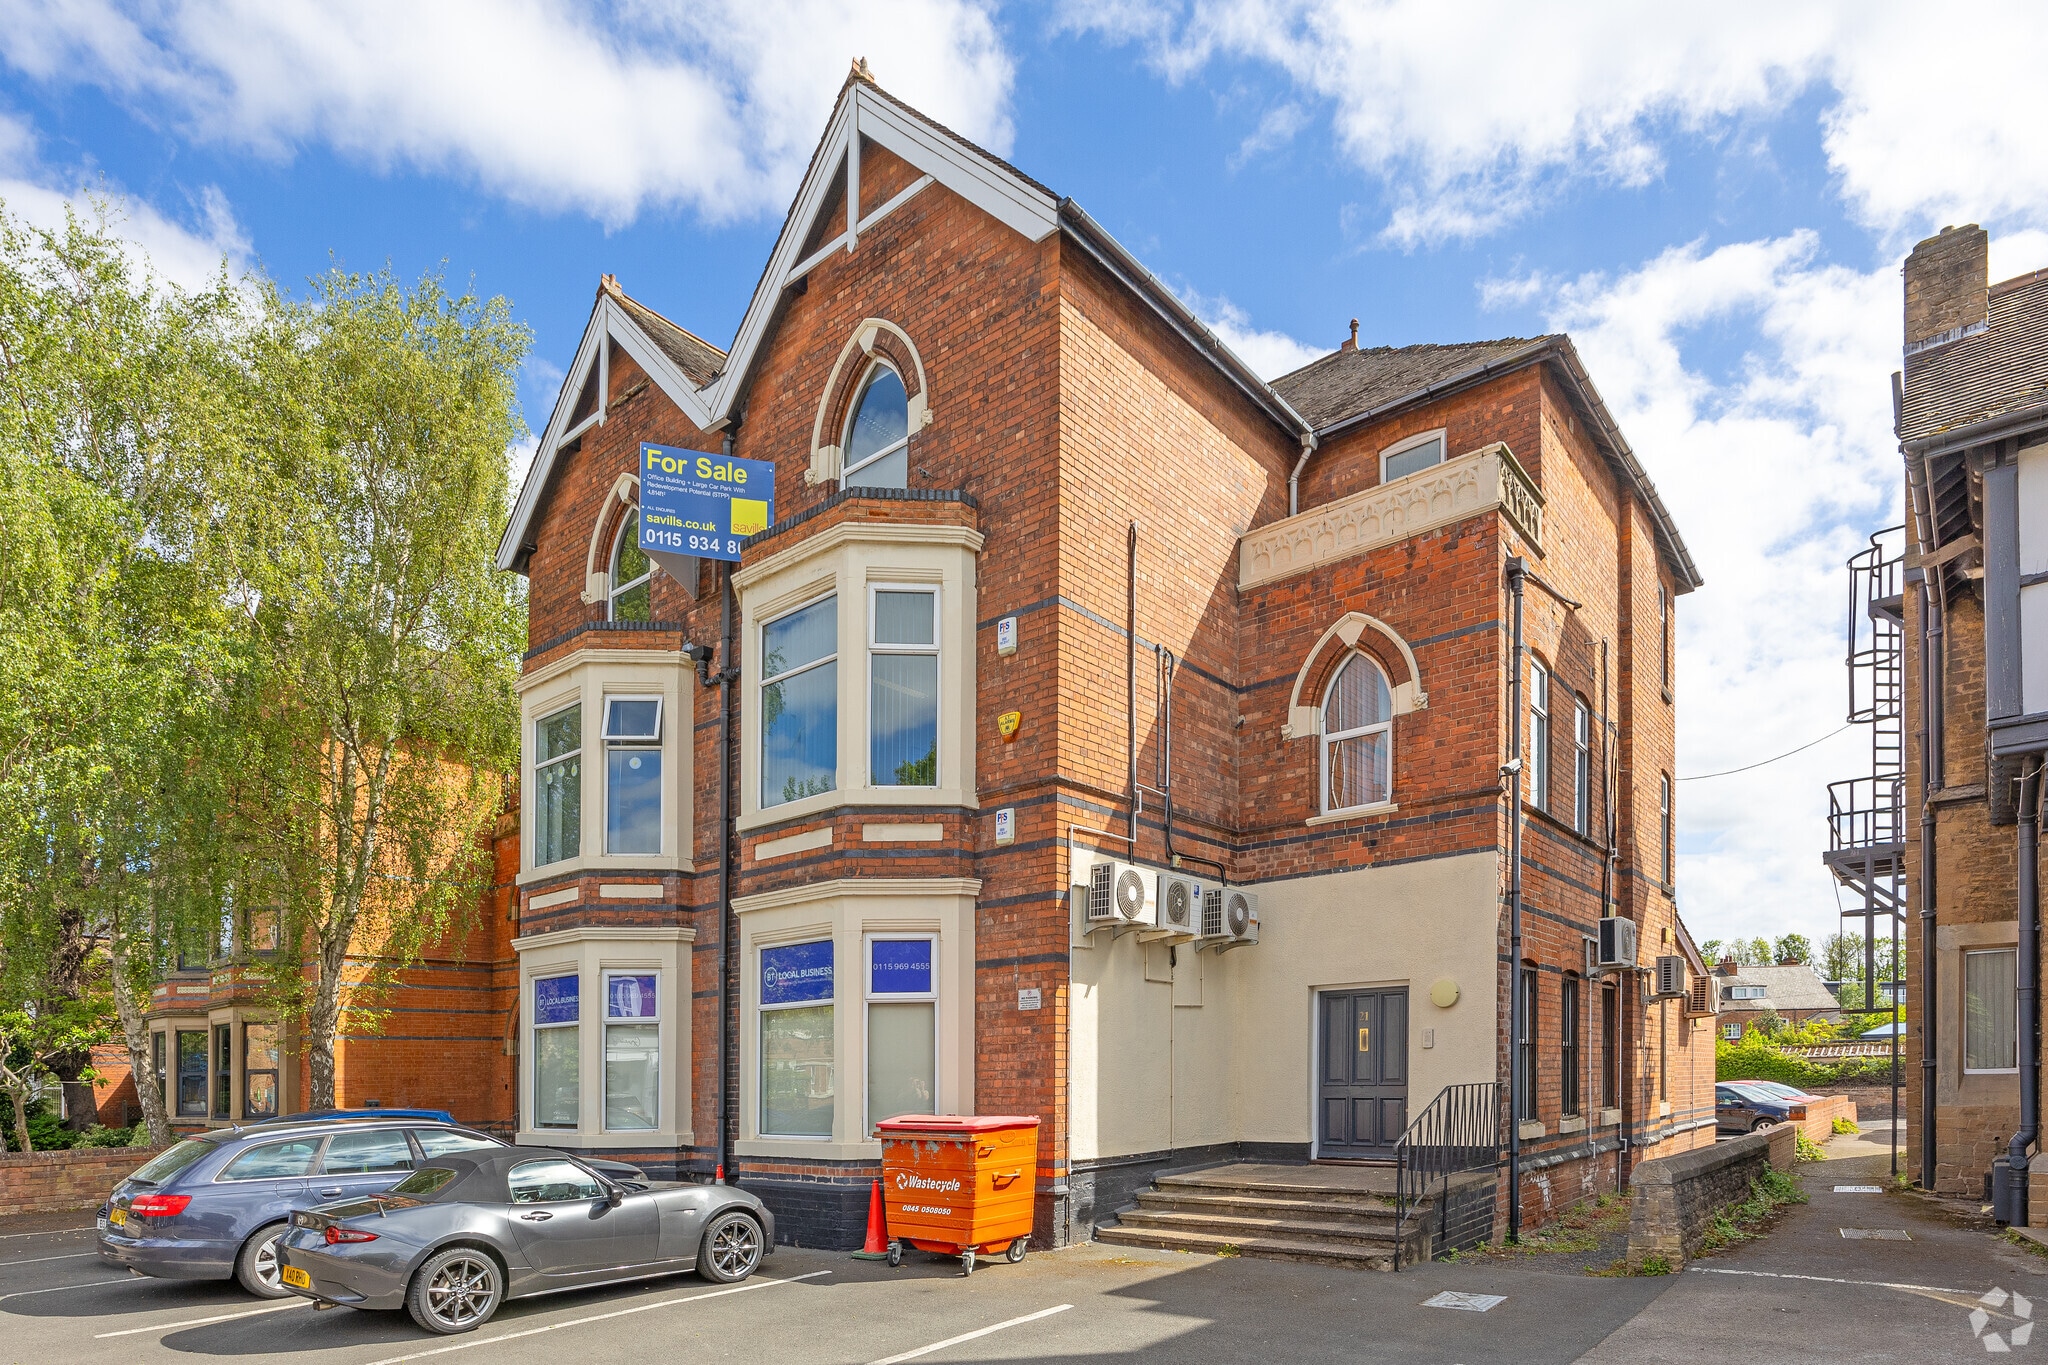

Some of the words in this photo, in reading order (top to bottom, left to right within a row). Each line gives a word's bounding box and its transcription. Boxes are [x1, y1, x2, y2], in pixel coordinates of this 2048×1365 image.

[647, 449, 688, 475] For
[696, 457, 748, 484] Sale
[647, 473, 664, 482] Office
[665, 476, 686, 486] Building
[692, 481, 708, 489] Large
[720, 484, 732, 492] Park
[733, 486, 746, 494] With
[647, 481, 688, 493] Redevelopment
[688, 487, 711, 497] Potential
[646, 514, 716, 532] savills.co.uk
[645, 529, 682, 547] 0115
[689, 535, 720, 552] 934
[727, 540, 741, 555] 8
[778, 970, 800, 980] LOCAL
[800, 966, 832, 978] BUSINESS
[873, 963, 893, 971] 0115
[894, 962, 909, 970] 969
[910, 962, 930, 970] 4555
[546, 997, 560, 1006] LOCAL
[560, 995, 579, 1004] BUSINES
[908, 1175, 961, 1193] Wastecycle
[902, 1204, 920, 1212] 0845
[921, 1206, 952, 1216] 0508050
